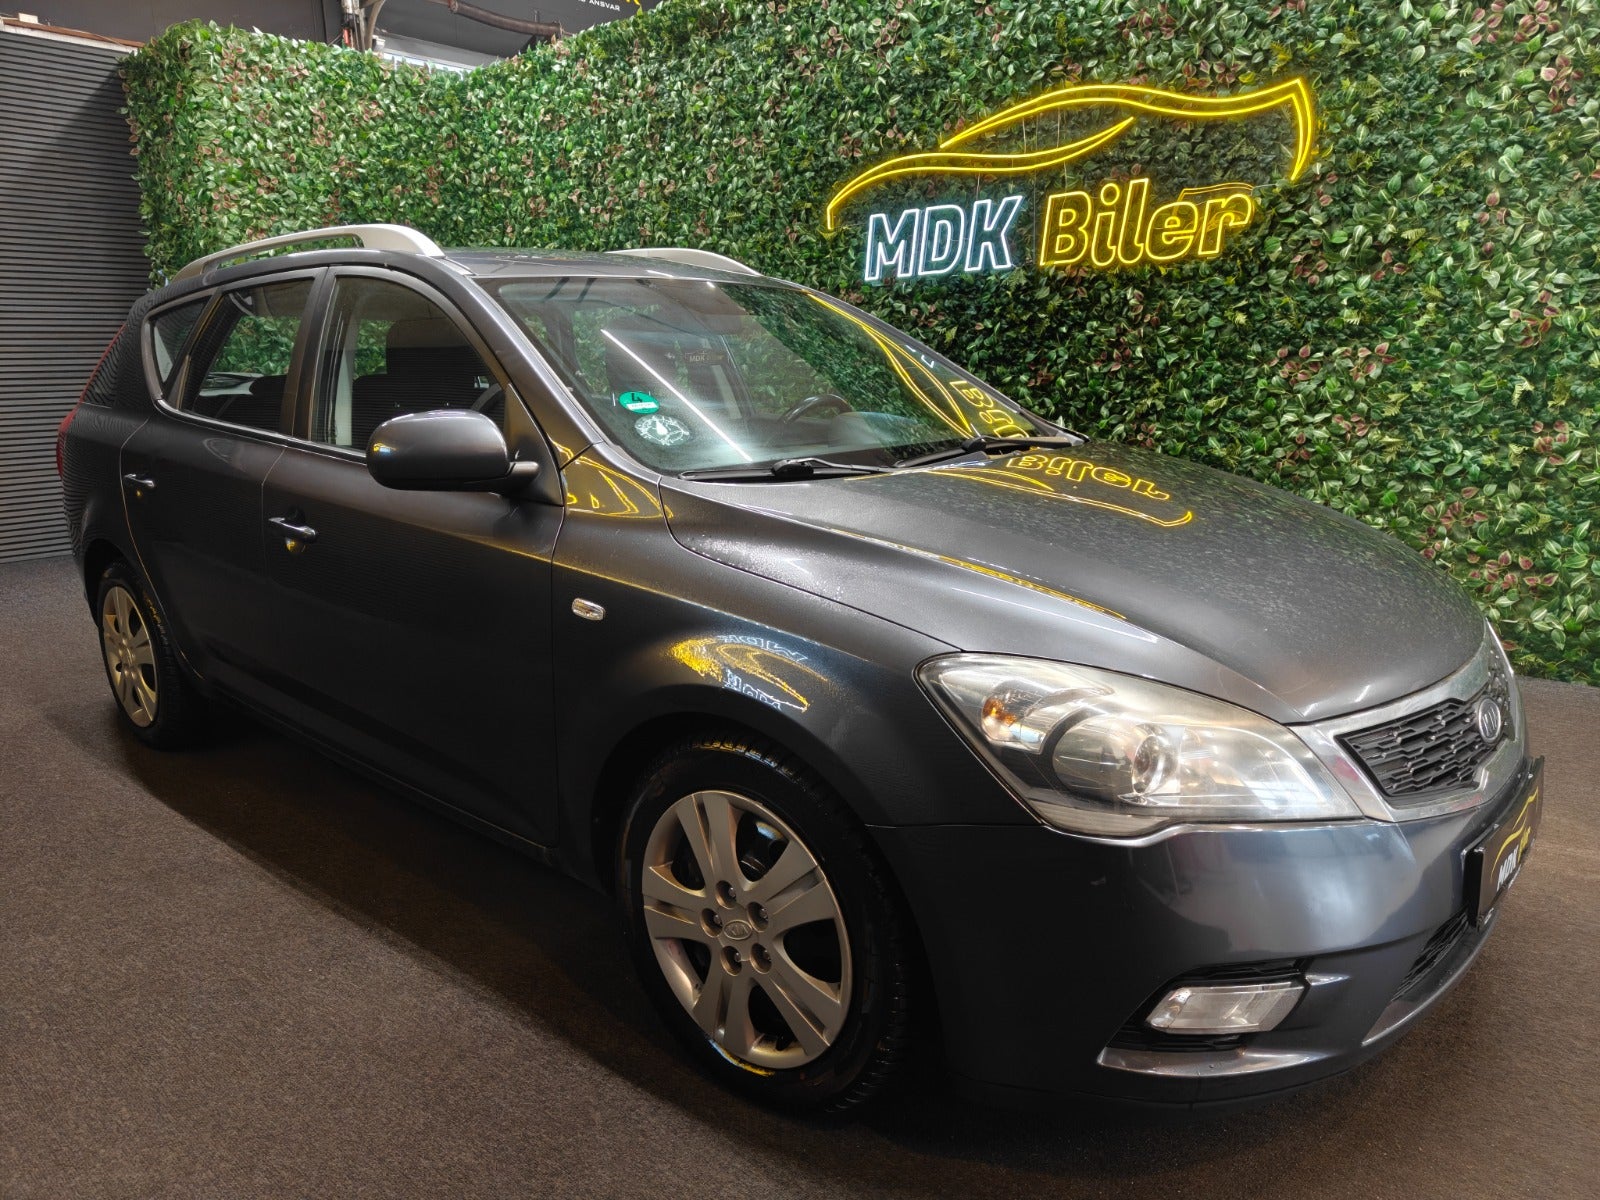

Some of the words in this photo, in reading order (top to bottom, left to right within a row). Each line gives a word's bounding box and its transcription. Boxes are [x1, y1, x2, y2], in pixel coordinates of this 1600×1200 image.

[588, 0, 621, 12] ANSVAR
[864, 194, 1024, 283] MDK
[1039, 177, 1258, 268] Biler
